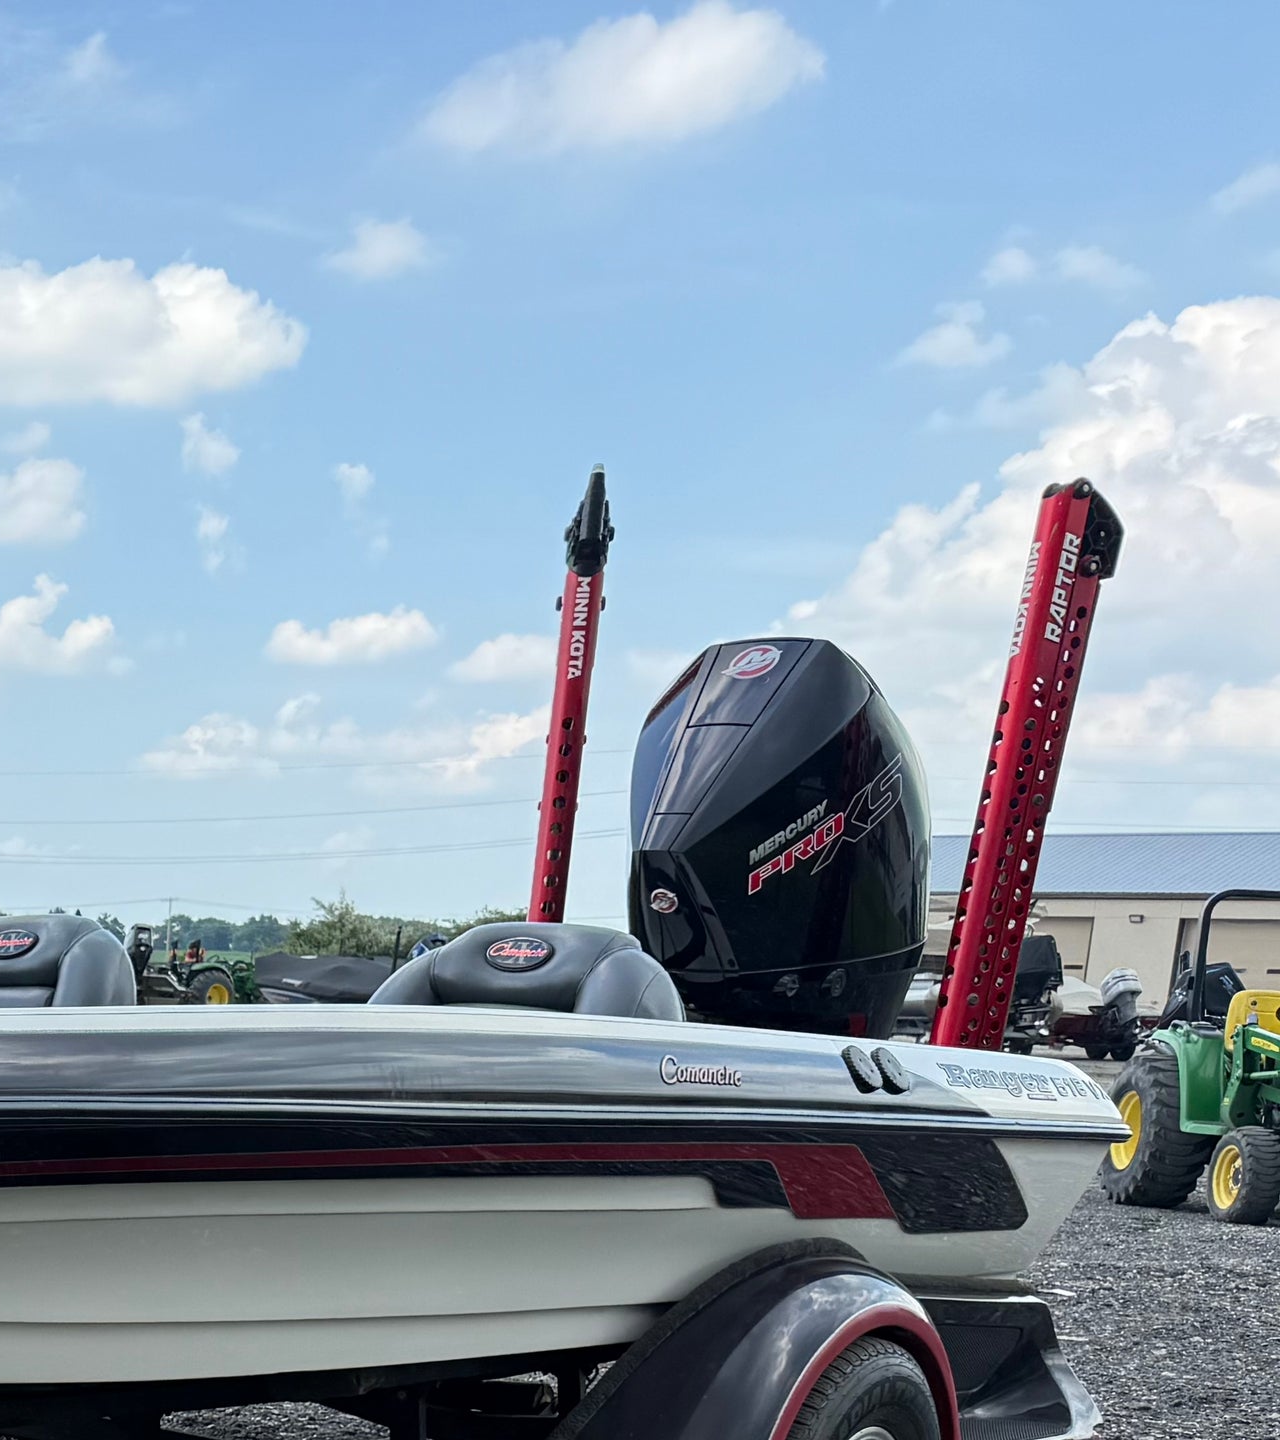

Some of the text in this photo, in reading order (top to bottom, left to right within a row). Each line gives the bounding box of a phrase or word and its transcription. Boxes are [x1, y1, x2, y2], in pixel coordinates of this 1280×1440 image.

[567, 576, 592, 680] MINN KOTA
[1009, 541, 1041, 659] MINN KOTA
[1044, 532, 1081, 643] RAPTOR
[749, 799, 828, 865] MERCURY
[660, 1054, 742, 1087] Comanche
[936, 1062, 1052, 1097] Ranger
